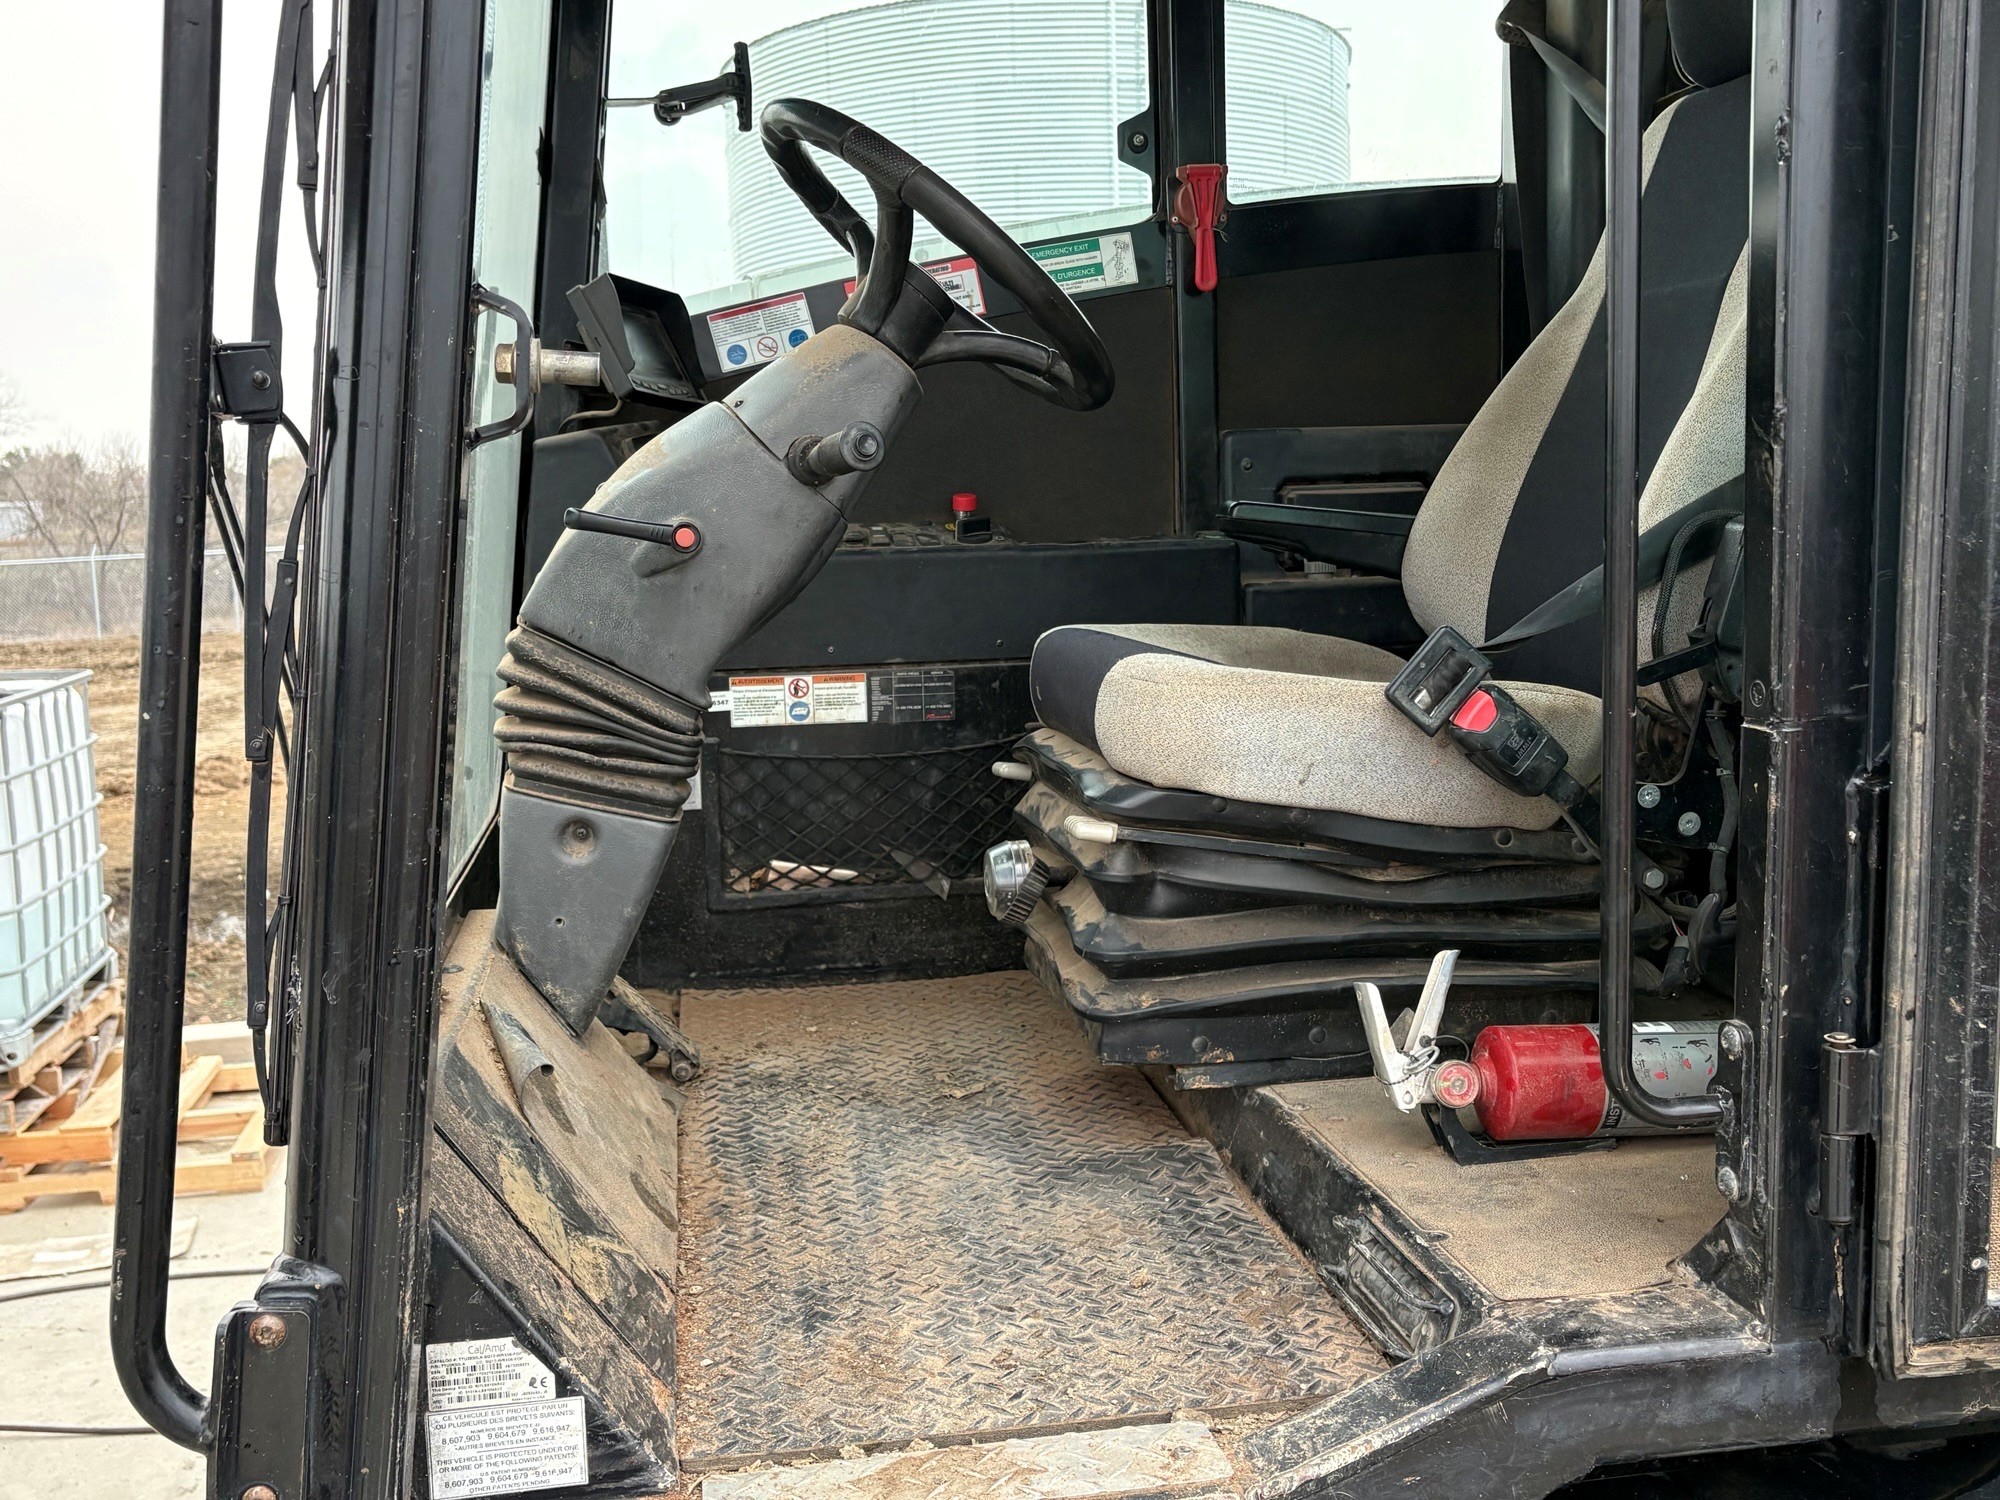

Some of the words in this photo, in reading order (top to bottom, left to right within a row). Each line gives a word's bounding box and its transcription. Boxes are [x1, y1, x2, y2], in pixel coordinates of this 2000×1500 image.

[1031, 246, 1073, 258] EMERGENCY
[1074, 244, 1089, 252] EXIT
[1058, 268, 1096, 280] D'URGENCE
[448, 1419, 488, 1428] PLUSIEURS
[506, 1414, 538, 1422] BREVETS
[532, 1424, 570, 1435] 9,616,947
[485, 1440, 514, 1448] BREVETS
[454, 1455, 484, 1464] VEHICLE
[494, 1449, 536, 1459] PROTECTED
[501, 1457, 542, 1466] FOLLOWING
[469, 1485, 491, 1493] OTHER
